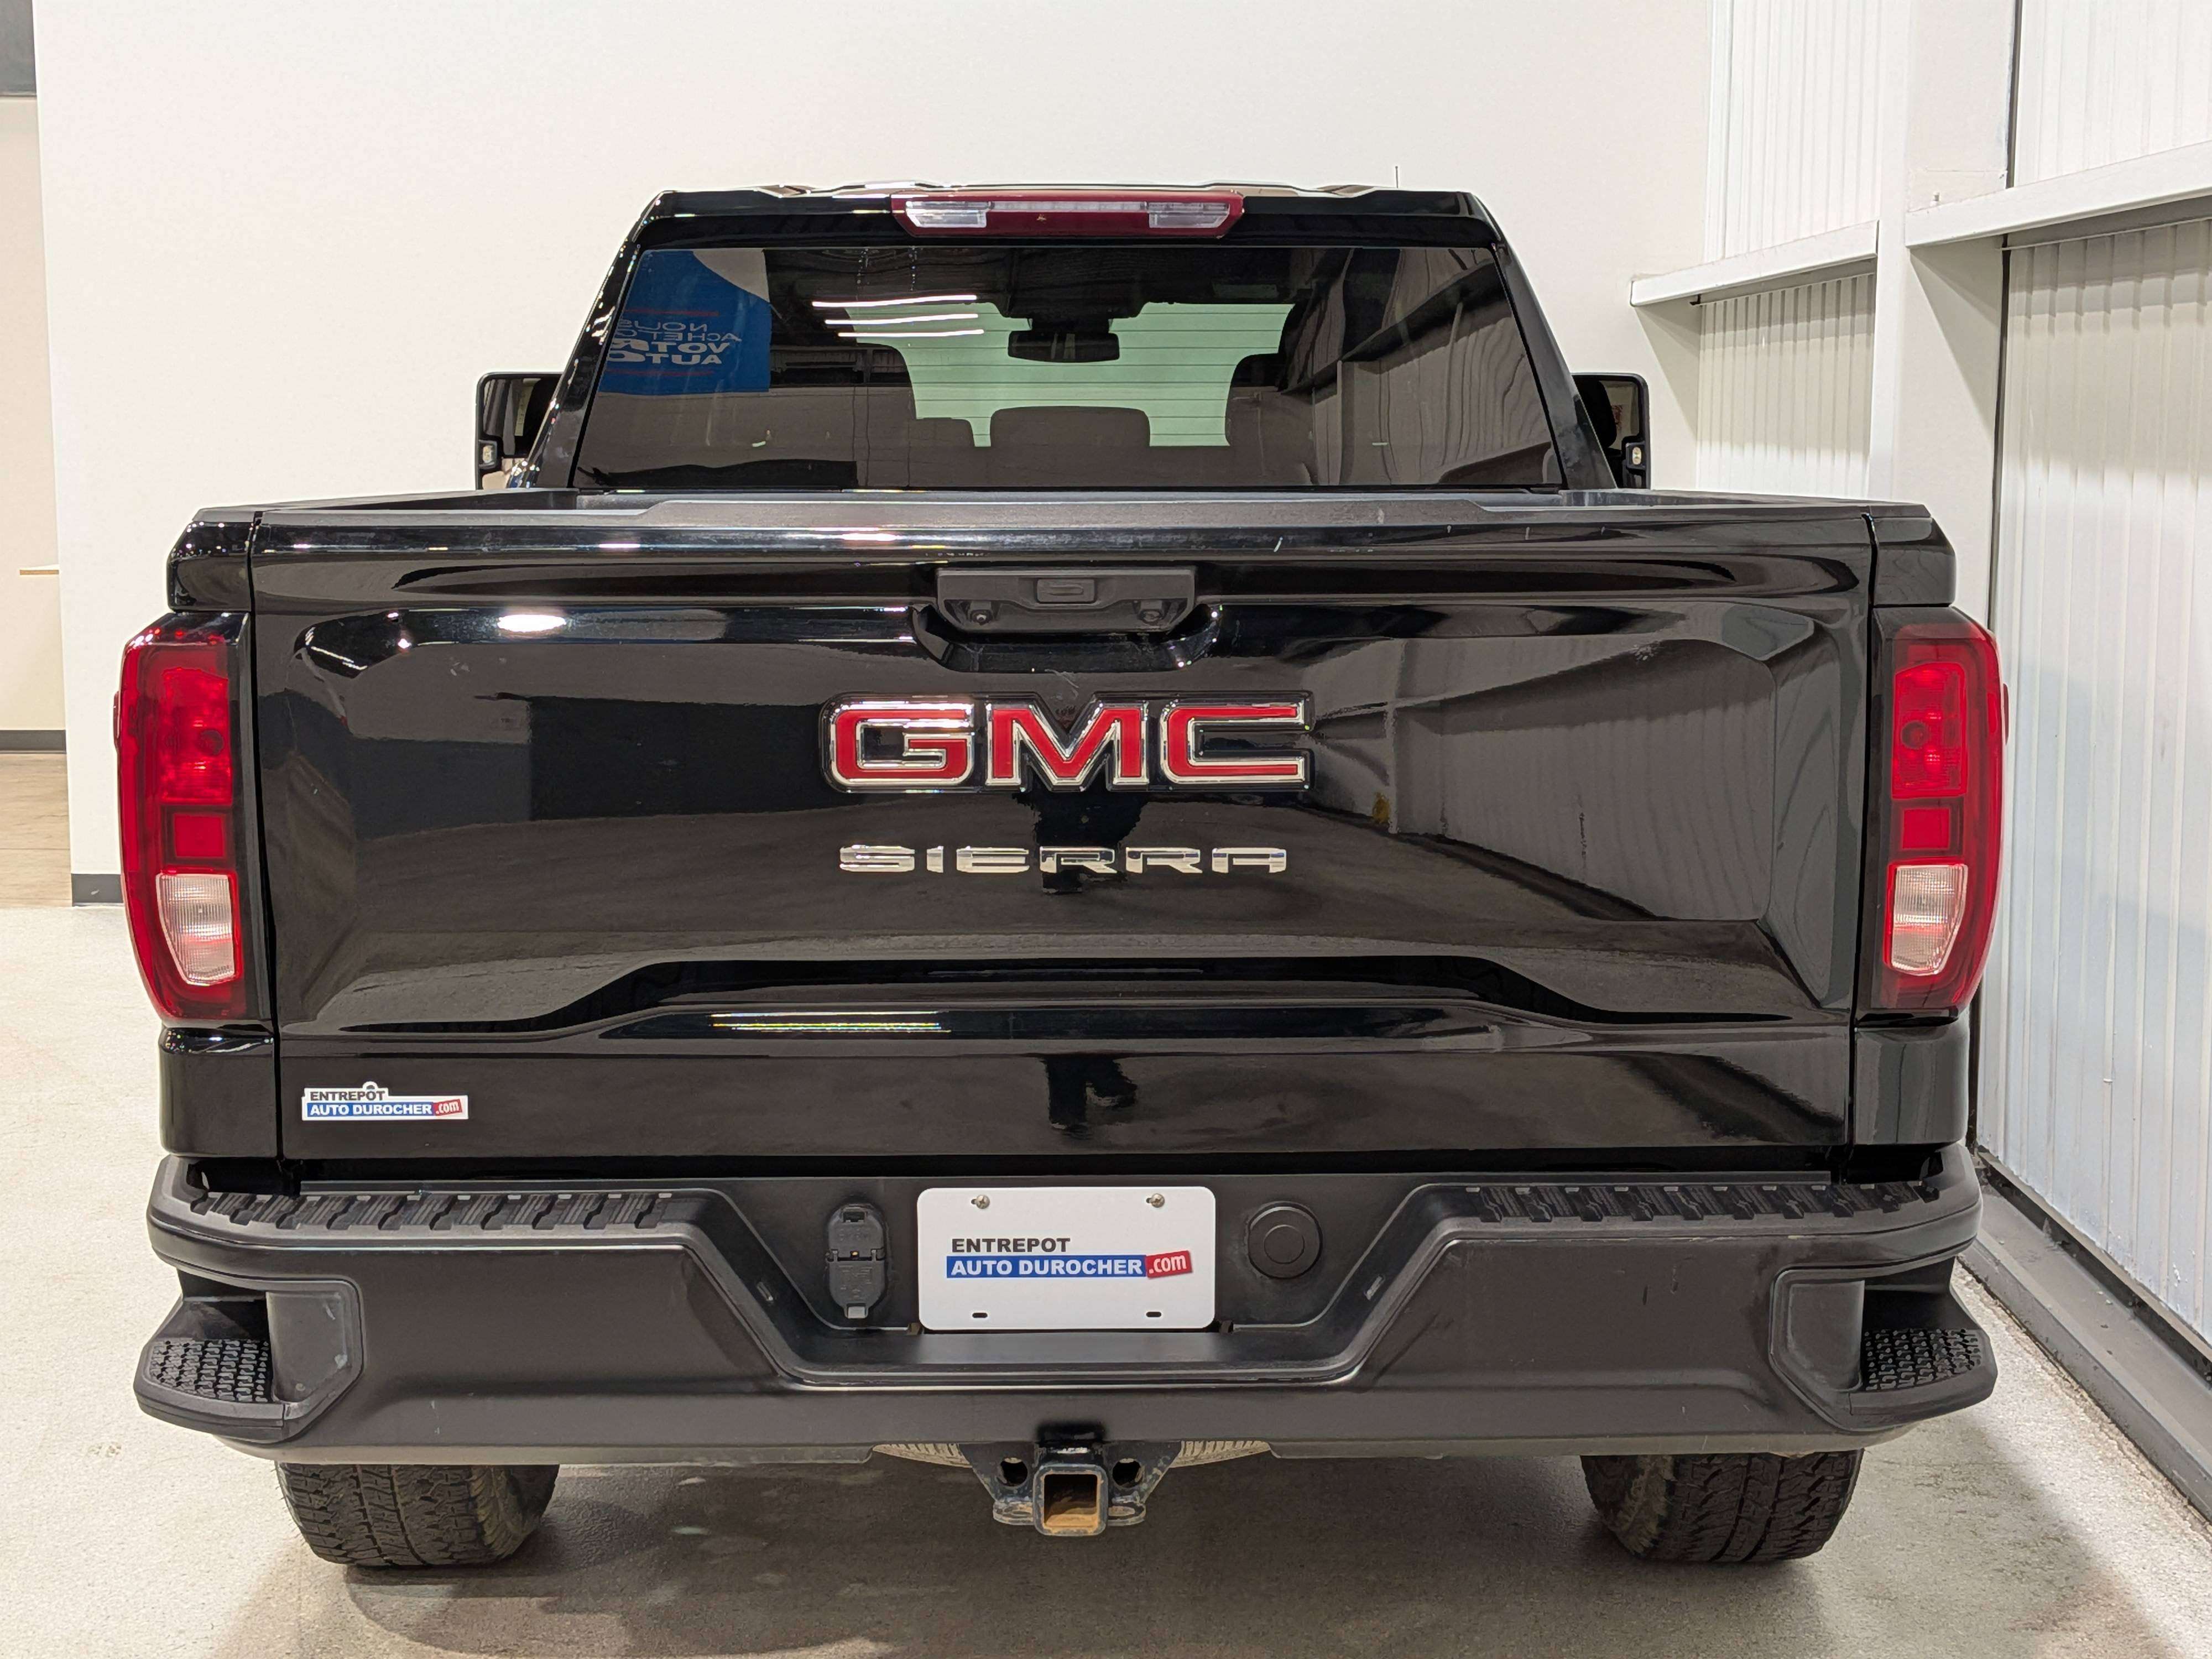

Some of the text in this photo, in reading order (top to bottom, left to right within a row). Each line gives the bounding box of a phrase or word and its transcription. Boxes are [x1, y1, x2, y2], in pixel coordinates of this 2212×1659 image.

[828, 700, 1308, 786] GMC
[838, 844, 1287, 874] SIERRA
[310, 1104, 350, 1116] AUTO
[952, 1238, 1071, 1253] ENTREPOT
[951, 1260, 1013, 1276] AUTO
